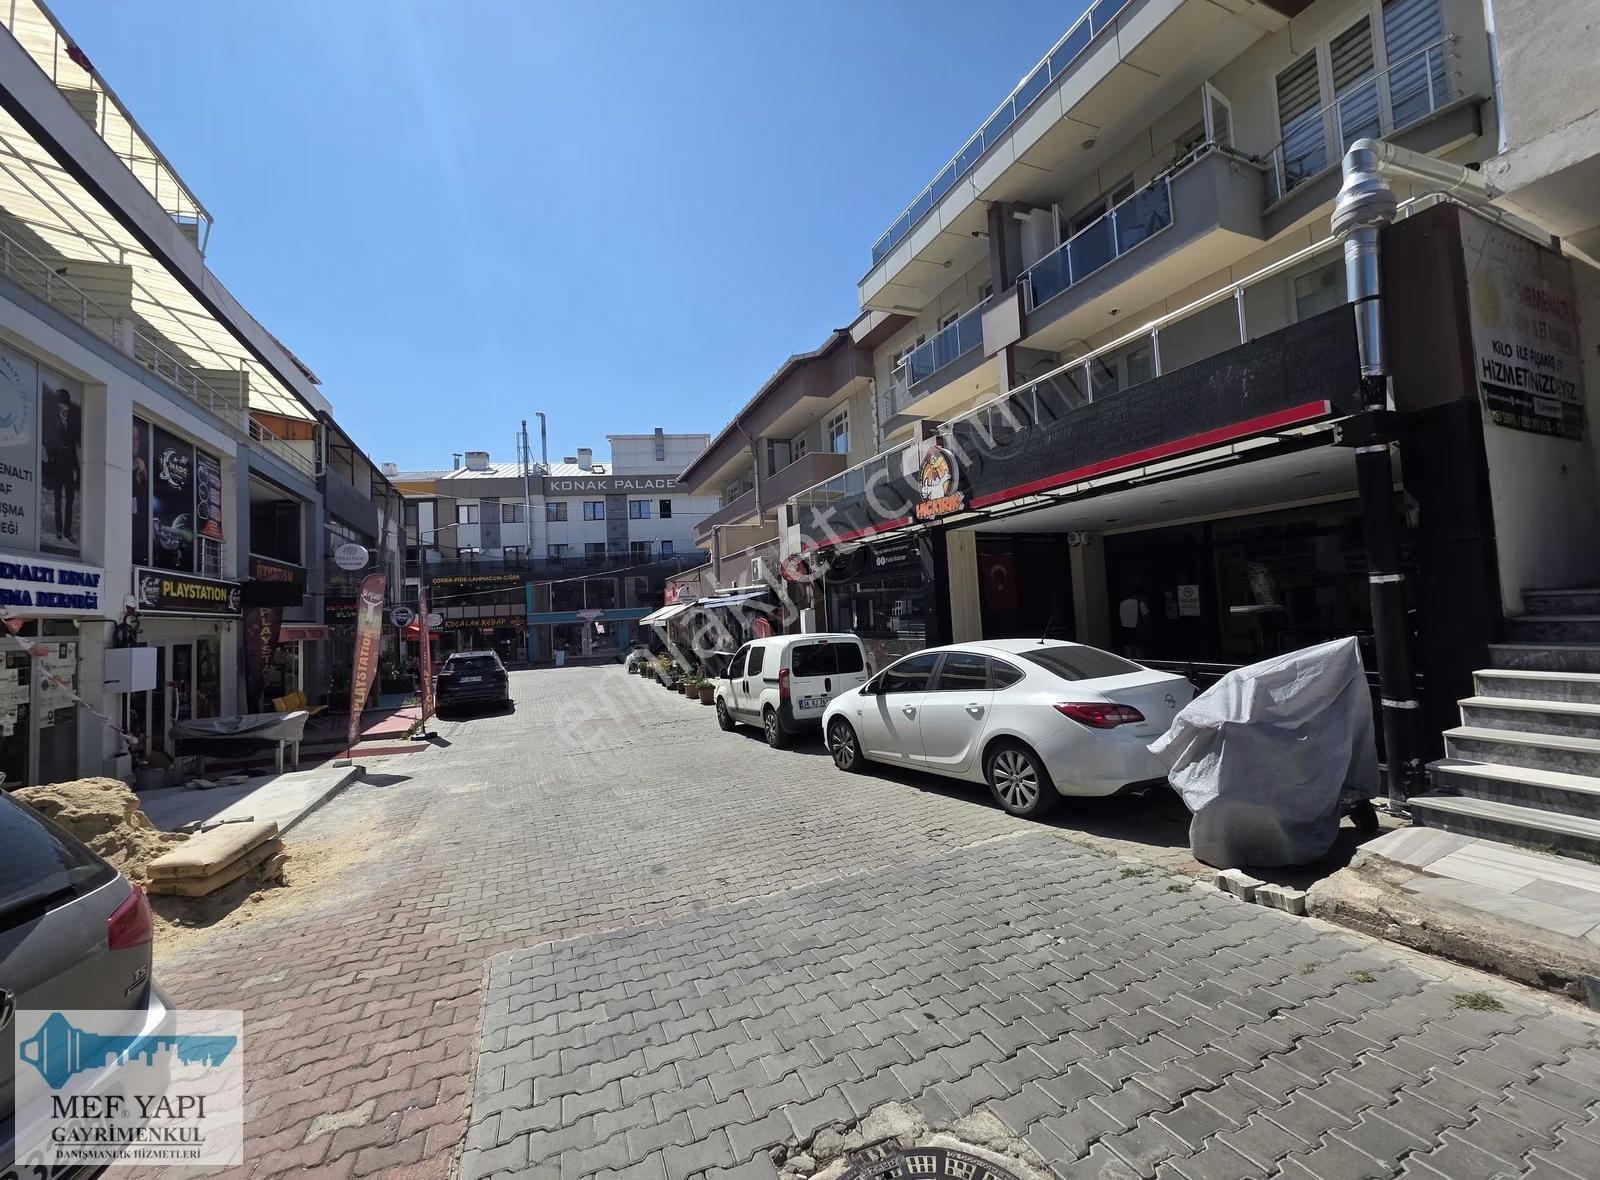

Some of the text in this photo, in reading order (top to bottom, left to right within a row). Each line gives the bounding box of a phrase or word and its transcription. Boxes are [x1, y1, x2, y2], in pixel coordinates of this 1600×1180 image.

[551, 479, 677, 491] KONAK PALACE
[162, 580, 227, 602] PLAYSTATION
